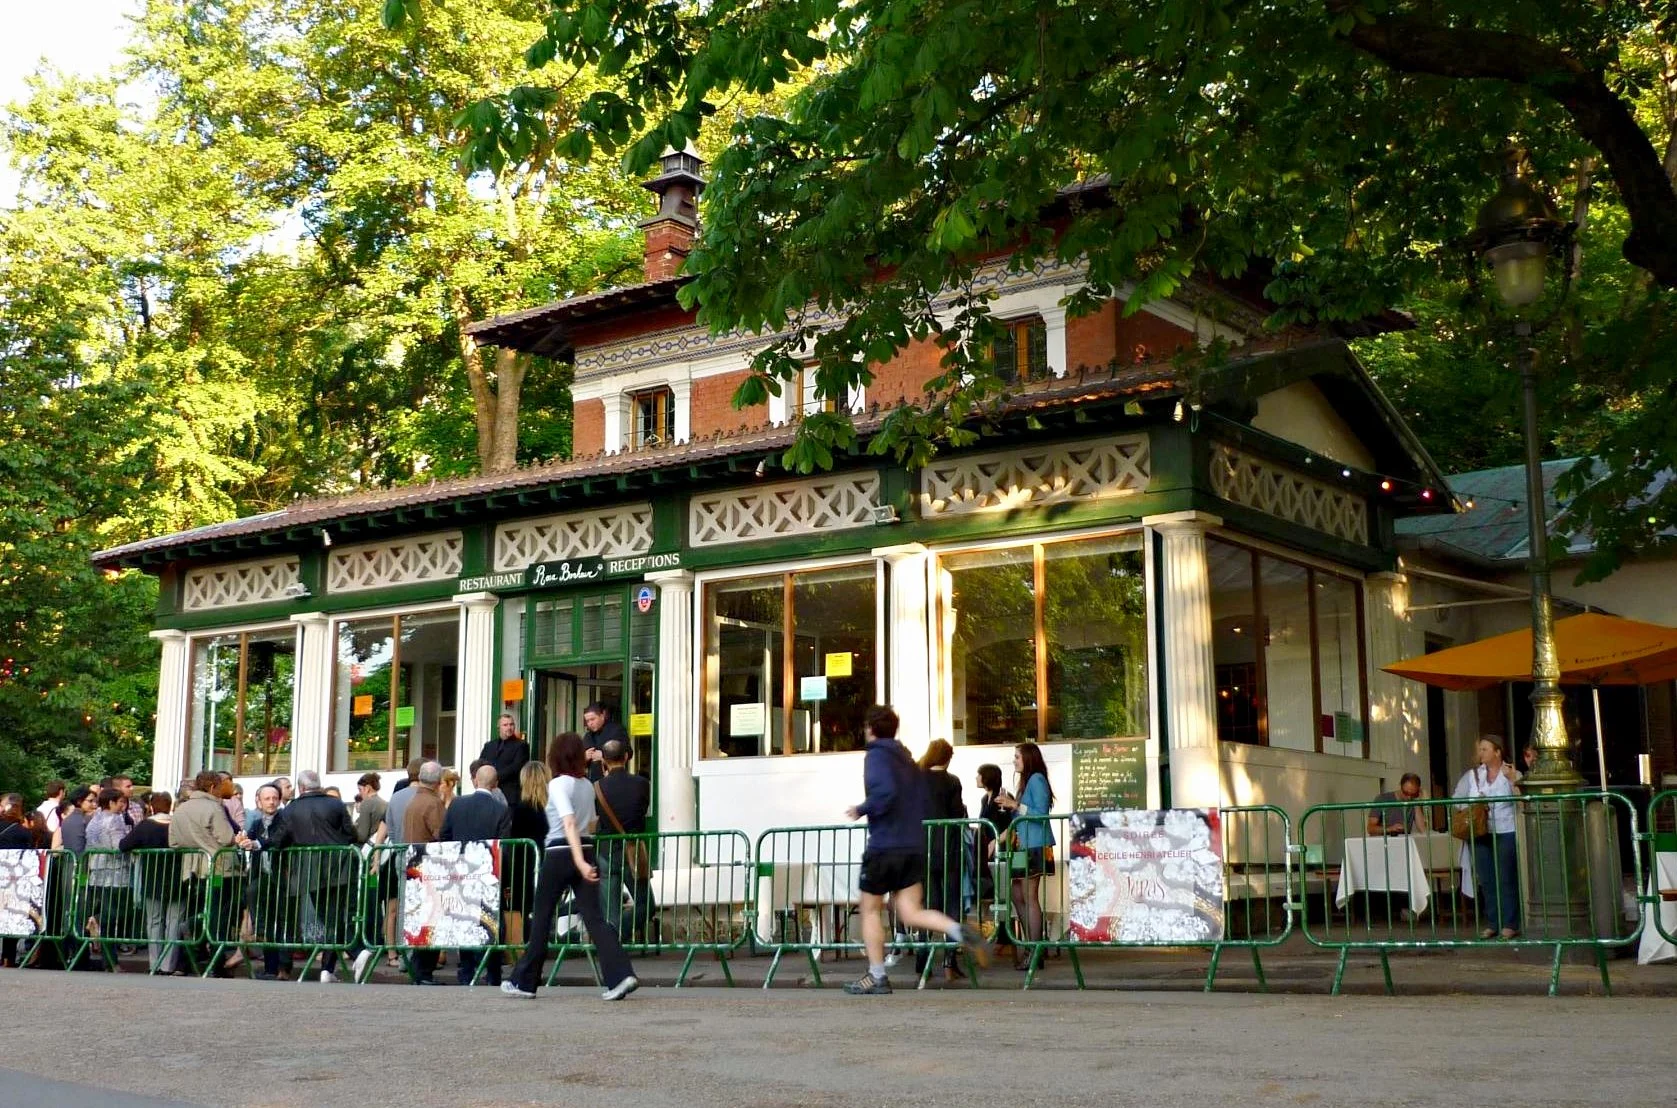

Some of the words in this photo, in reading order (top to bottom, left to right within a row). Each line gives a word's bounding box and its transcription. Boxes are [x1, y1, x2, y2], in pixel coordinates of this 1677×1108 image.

[459, 572, 523, 592] RESTAURANT
[559, 562, 598, 582] Bonheur
[610, 553, 680, 574] RECEPTIONS
